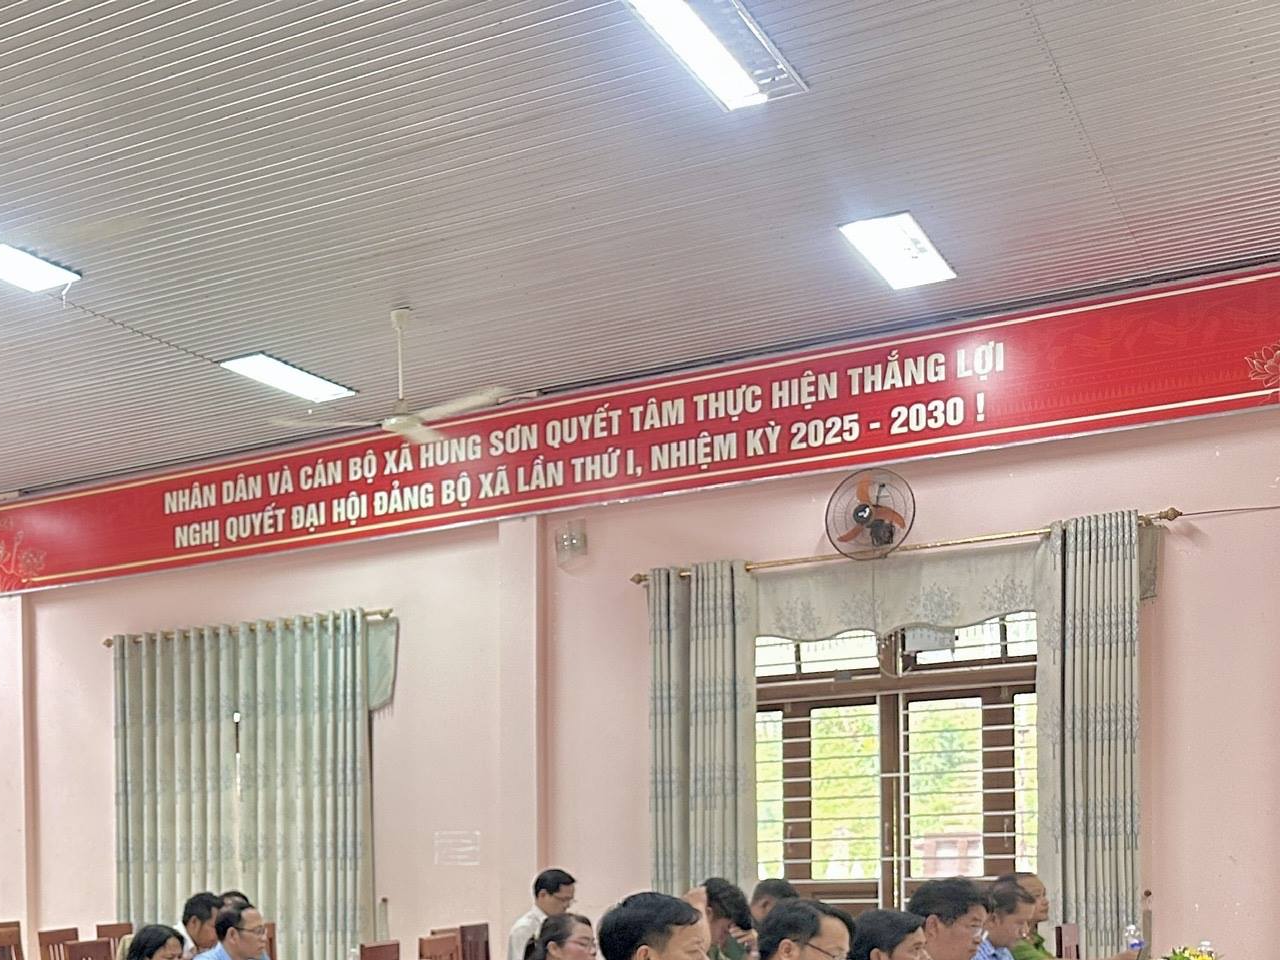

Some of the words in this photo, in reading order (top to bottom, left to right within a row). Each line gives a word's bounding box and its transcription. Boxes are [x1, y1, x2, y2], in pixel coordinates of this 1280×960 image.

[164, 482, 216, 514] NHÂN
[222, 473, 262, 504] DÂN
[268, 465, 294, 496] VÀ
[299, 458, 342, 490] CÁN
[349, 449, 377, 483] BỘ
[383, 443, 413, 476] XÃ
[489, 424, 538, 456] SƠN
[546, 403, 622, 448] QUYẾT
[630, 398, 685, 432] TÂM
[693, 384, 762, 423] THỰC
[771, 371, 838, 410] HIỆN
[847, 349, 946, 396] THẮNG
[956, 341, 1005, 382] LỢI
[175, 520, 219, 548] NGHỊ
[225, 502, 286, 543] QUYẾT
[291, 501, 325, 532] ĐẠI
[332, 491, 368, 525] HỘI
[373, 480, 434, 517] ĐẢNG
[441, 472, 471, 508] BỘ
[478, 465, 510, 499] XÃ
[517, 455, 564, 493] LẦN
[571, 447, 621, 483] THỨ
[626, 449, 642, 477] I,
[651, 431, 737, 471] NHIỆM
[746, 420, 781, 457] KỲ
[790, 413, 860, 450] 2025
[890, 397, 965, 435] 2030
